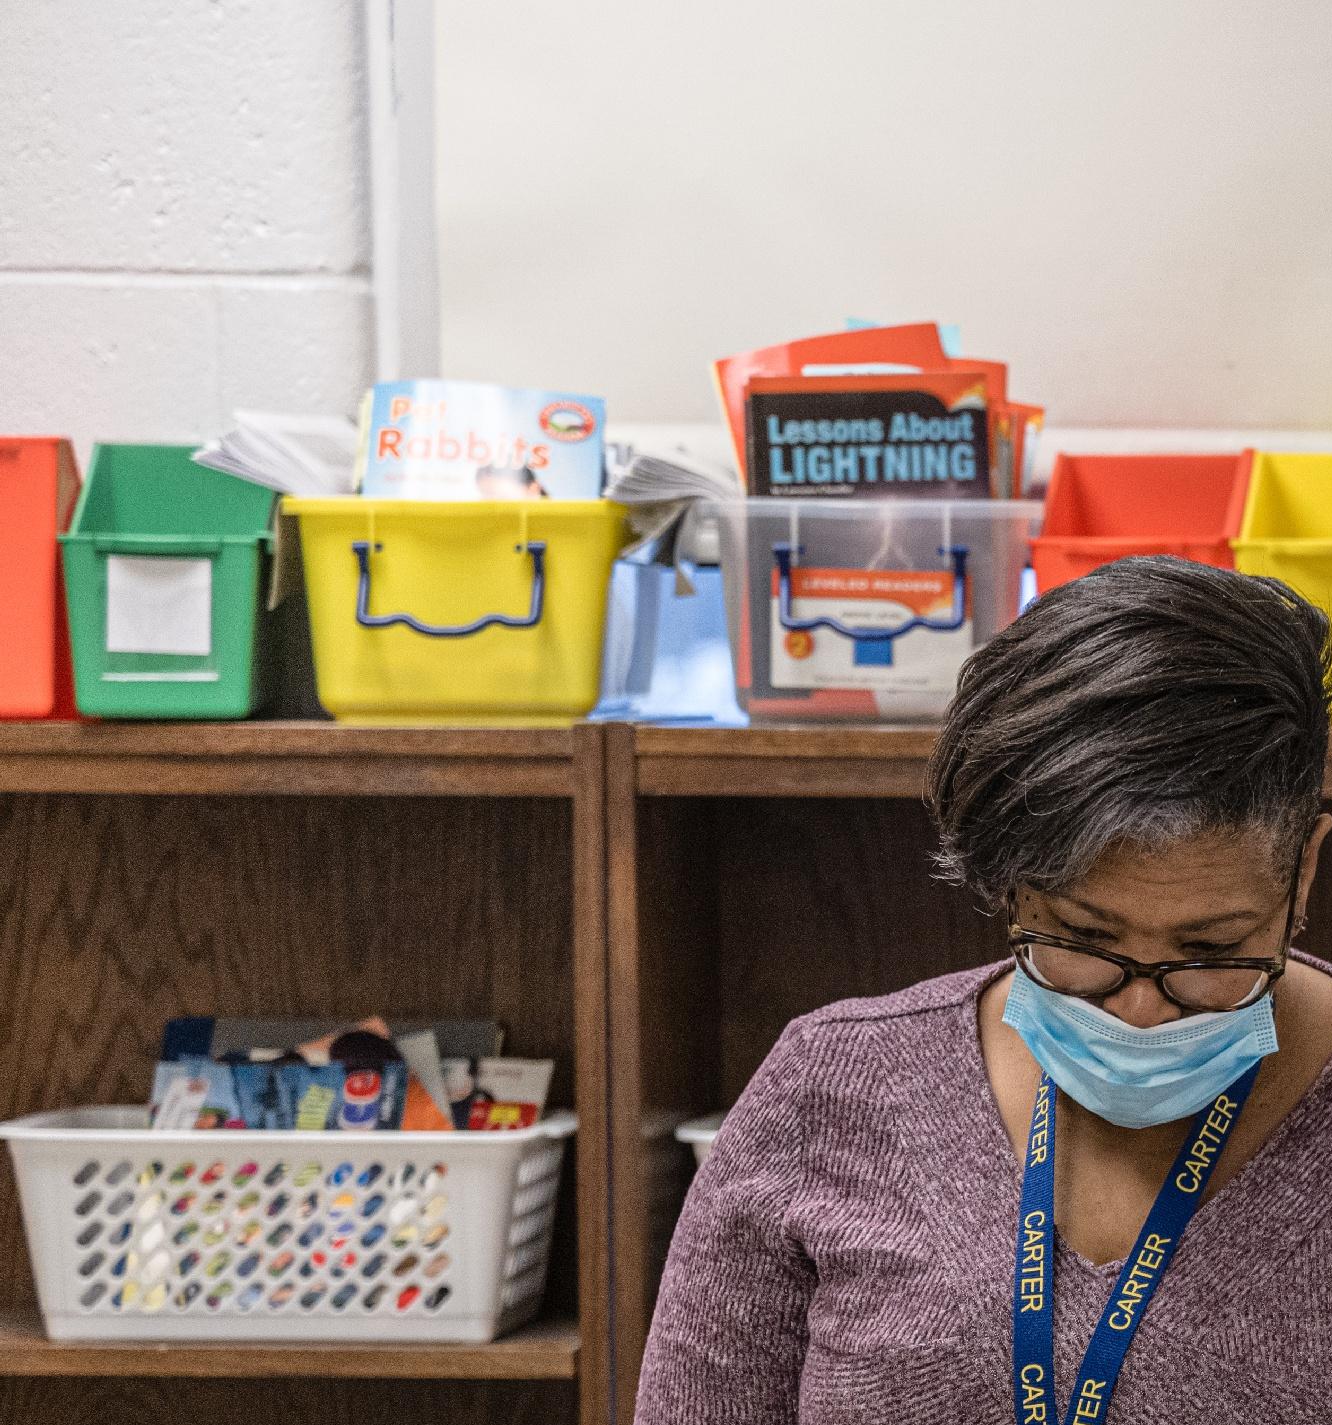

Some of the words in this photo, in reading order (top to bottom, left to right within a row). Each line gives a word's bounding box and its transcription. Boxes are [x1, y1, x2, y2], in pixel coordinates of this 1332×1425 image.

[390, 396, 447, 424] Pet
[767, 415, 884, 445] Lessons
[890, 412, 974, 443] About
[377, 428, 551, 470] Rabbits
[769, 443, 977, 484] LIGHTNING
[1030, 1069, 1050, 1168] ARTER
[1175, 1094, 1238, 1196] CARTER
[1020, 1209, 1046, 1313] CARTER
[1108, 1232, 1172, 1332] CARTER
